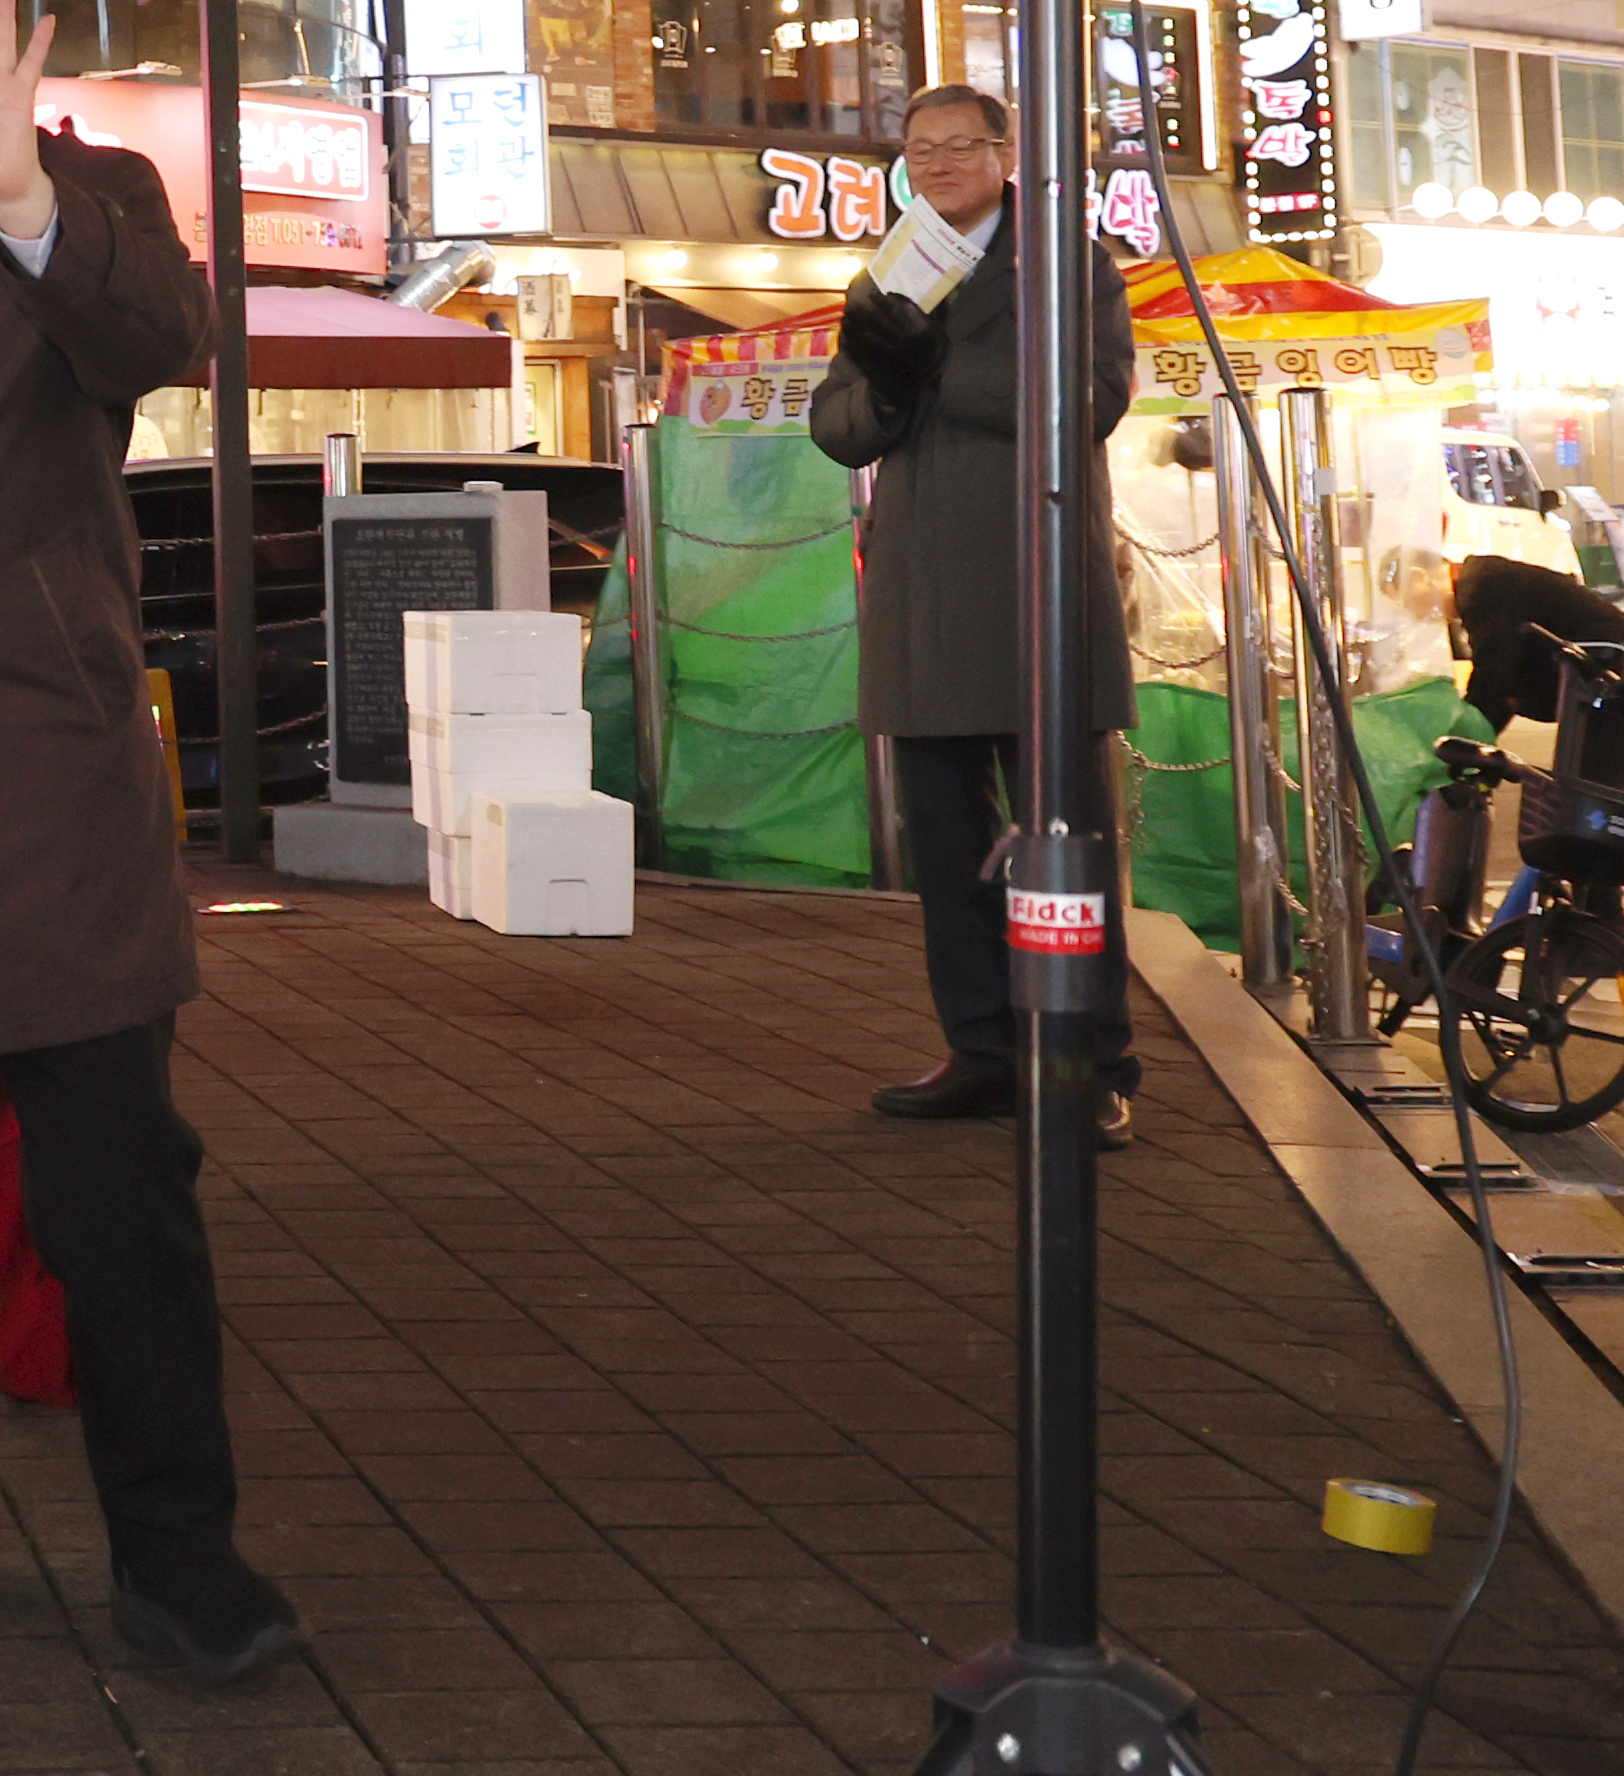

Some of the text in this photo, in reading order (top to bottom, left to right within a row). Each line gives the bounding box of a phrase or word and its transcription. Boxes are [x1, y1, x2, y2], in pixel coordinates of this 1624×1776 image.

[760, 145, 913, 243] 고려
[1152, 344, 1438, 398] 황금잉어빵
[740, 377, 810, 420] 황금
